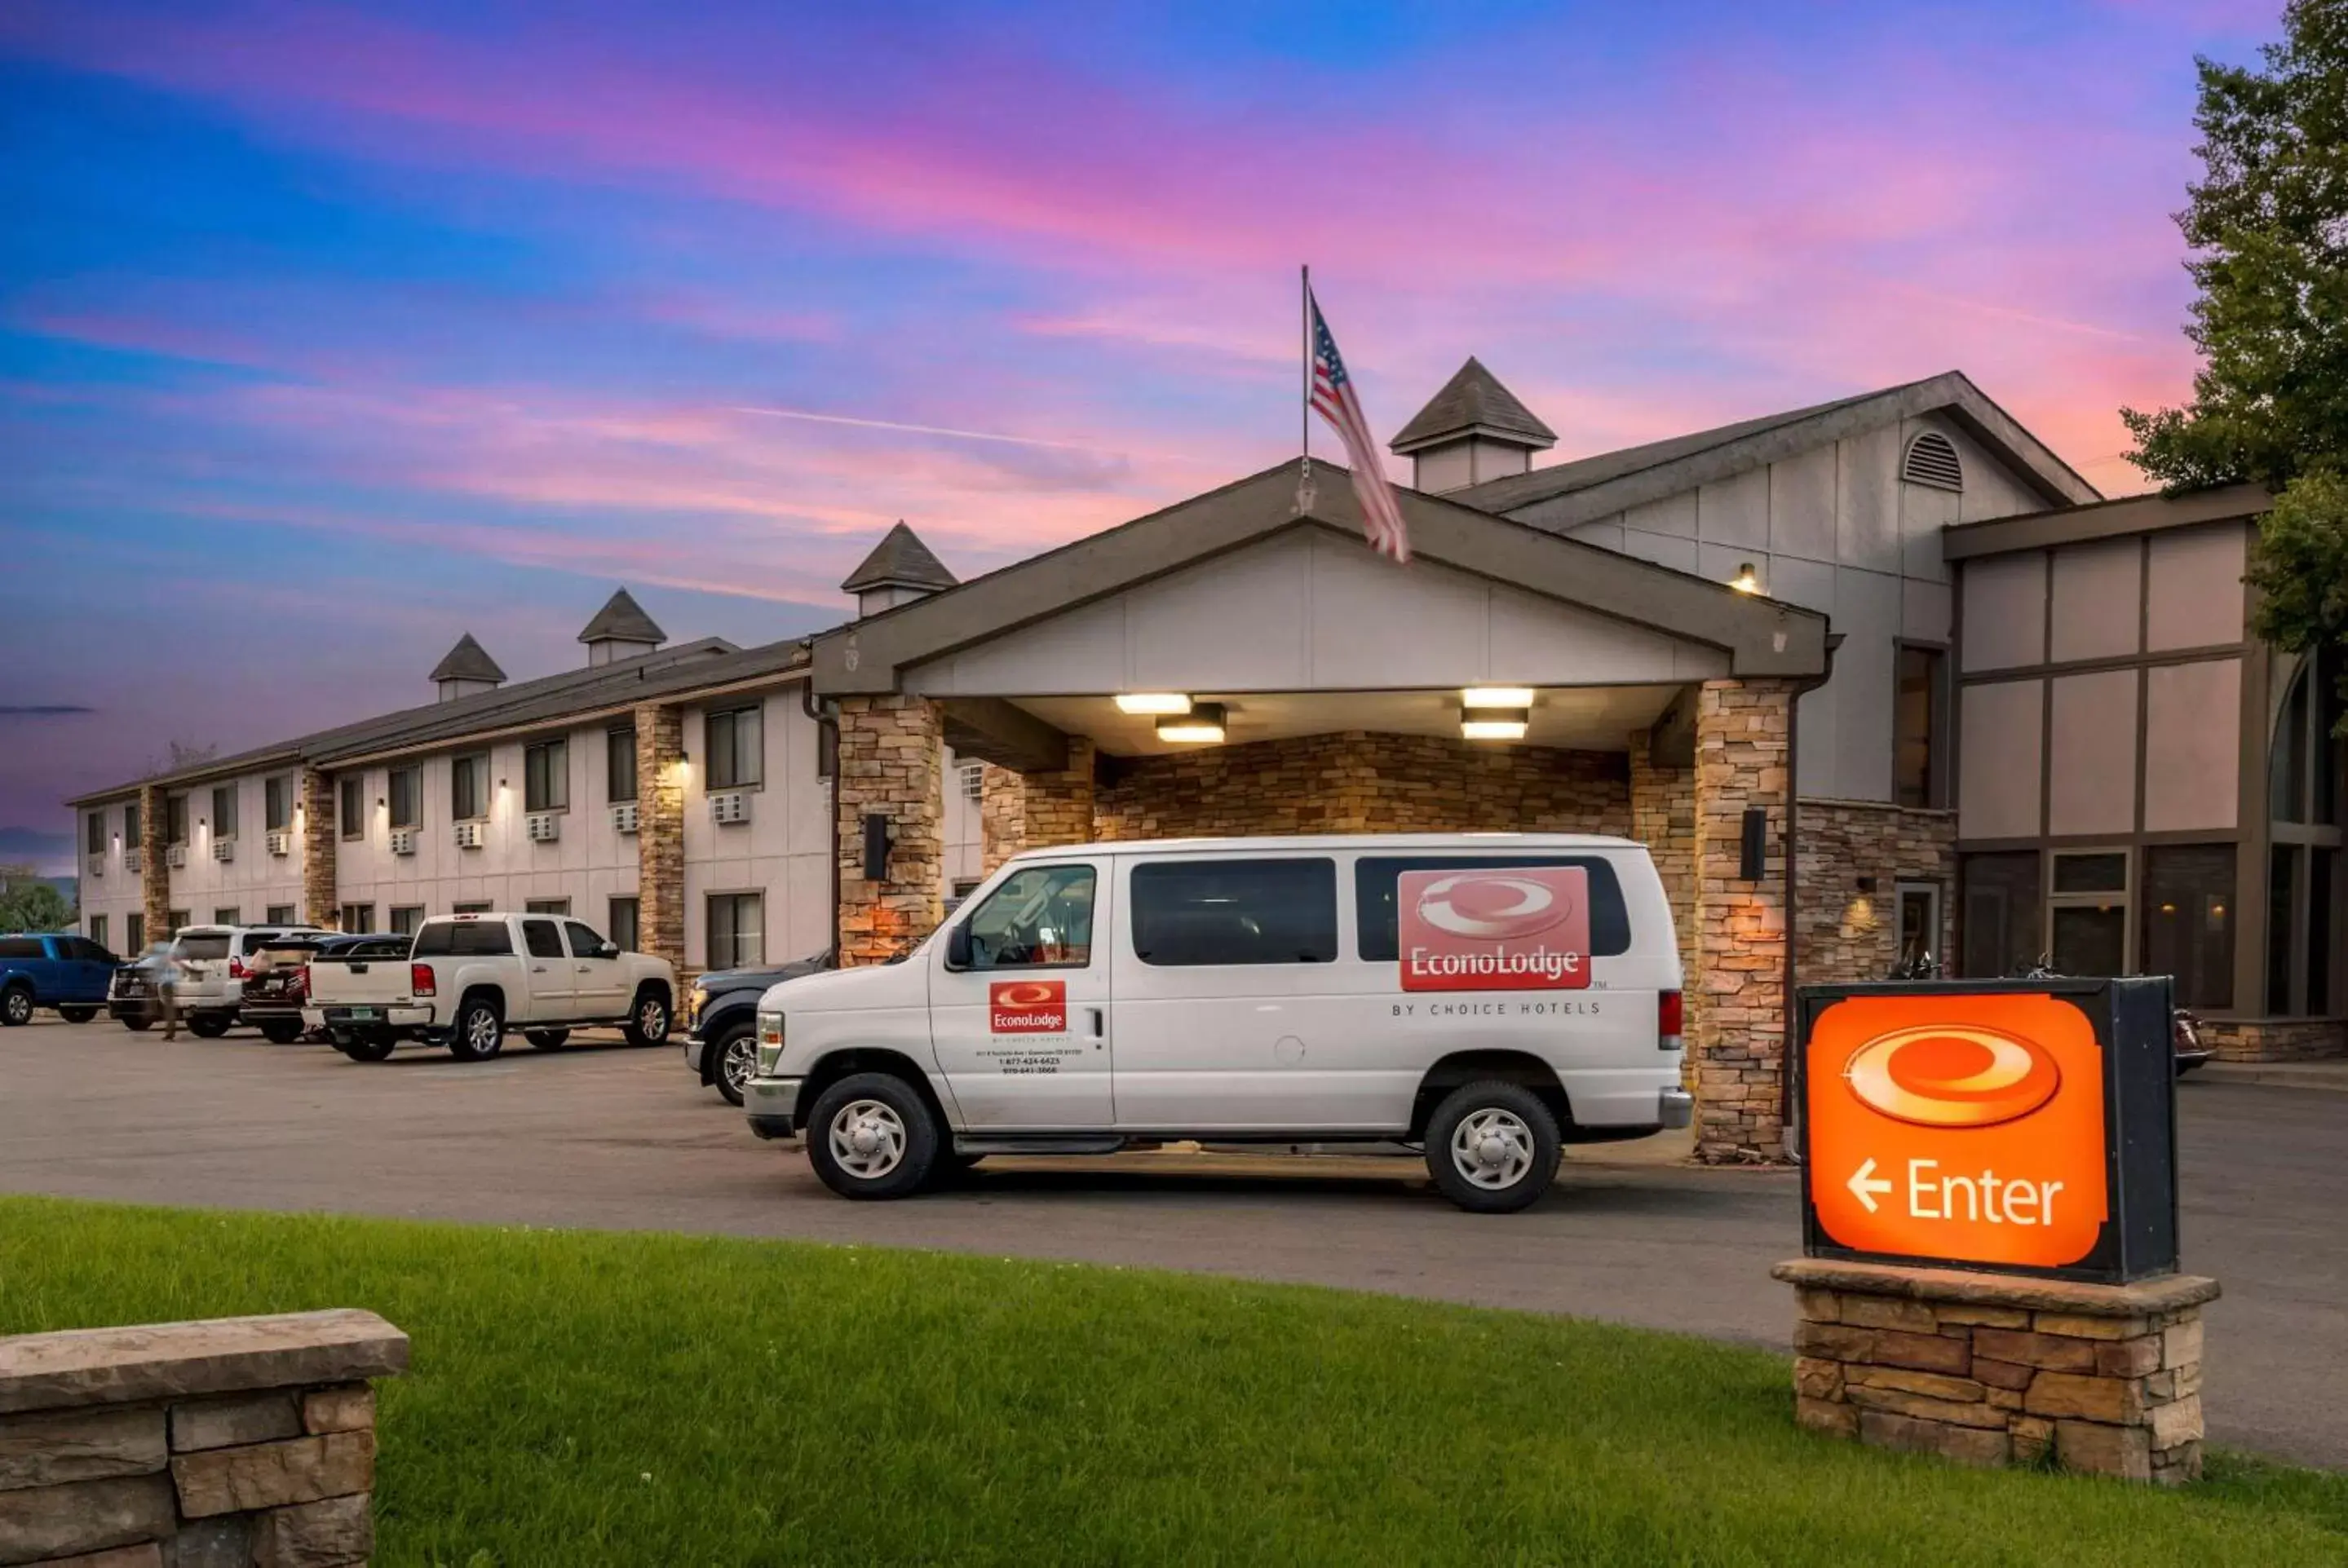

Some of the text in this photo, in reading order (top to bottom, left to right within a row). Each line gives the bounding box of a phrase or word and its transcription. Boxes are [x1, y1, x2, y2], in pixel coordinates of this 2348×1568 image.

[1411, 945, 1579, 980] EconoLodge
[994, 1012, 1062, 1029] EconoLodge
[1392, 1002, 1600, 1016] BY CHOICE HOTELS
[1908, 1159, 2064, 1226] Enter
